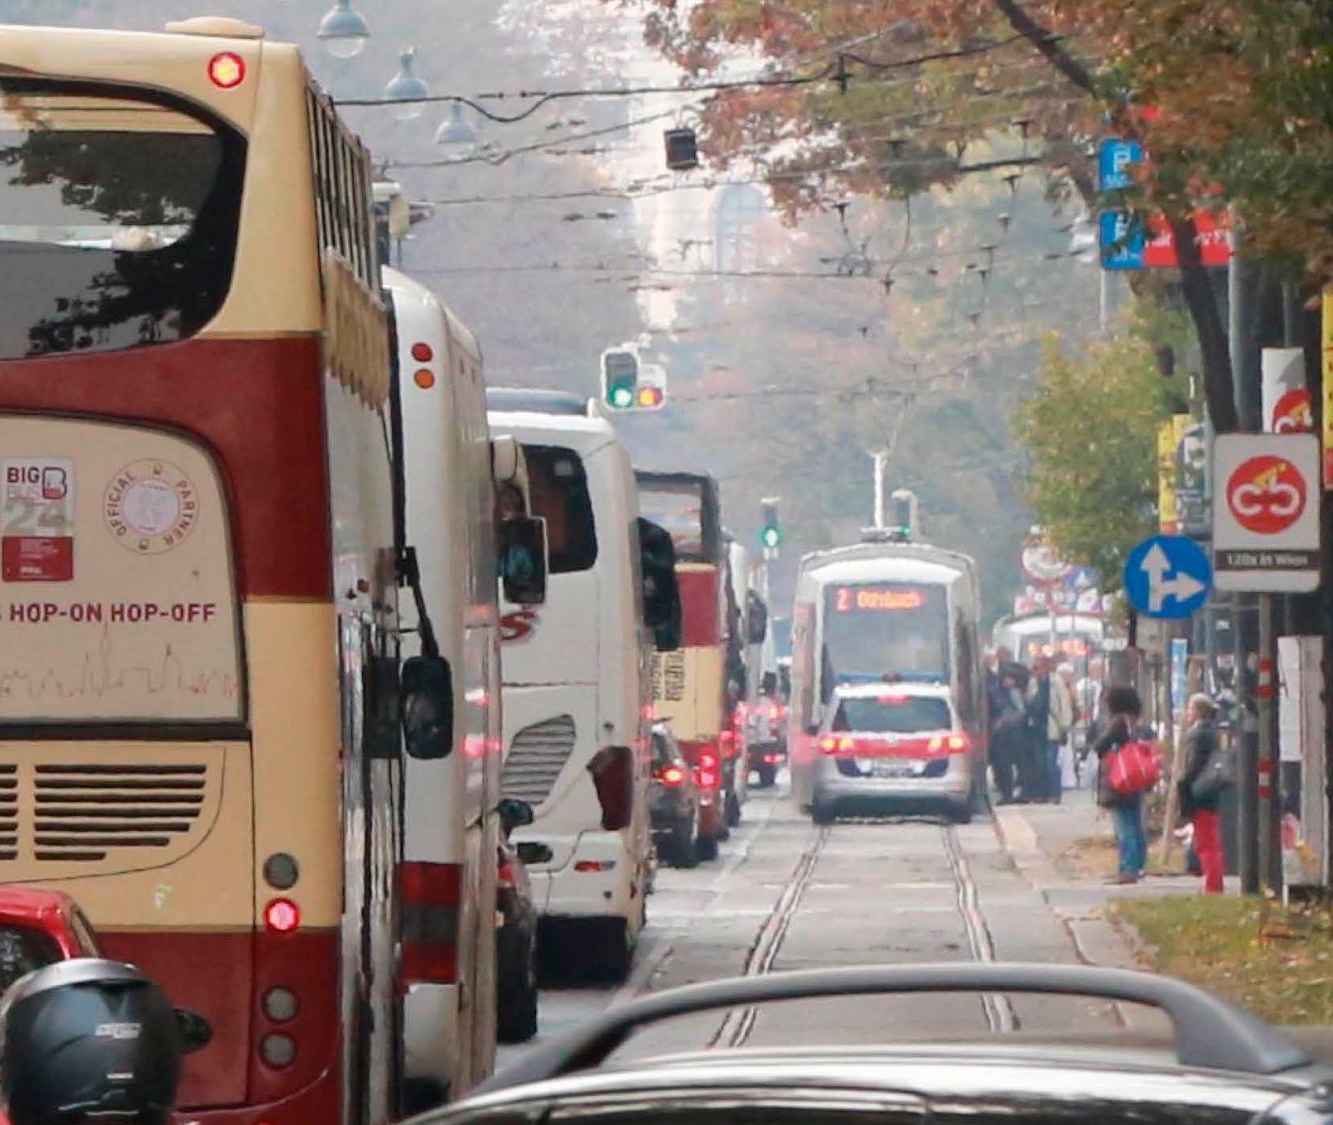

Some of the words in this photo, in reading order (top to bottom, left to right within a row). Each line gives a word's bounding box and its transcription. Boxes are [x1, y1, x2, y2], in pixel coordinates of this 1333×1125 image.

[7, 466, 40, 484] BIG
[106, 471, 137, 537] OFFICIAL
[162, 480, 196, 545] PARTNER
[9, 603, 102, 622] HOP-ON
[111, 603, 216, 622] HOP-OFF
